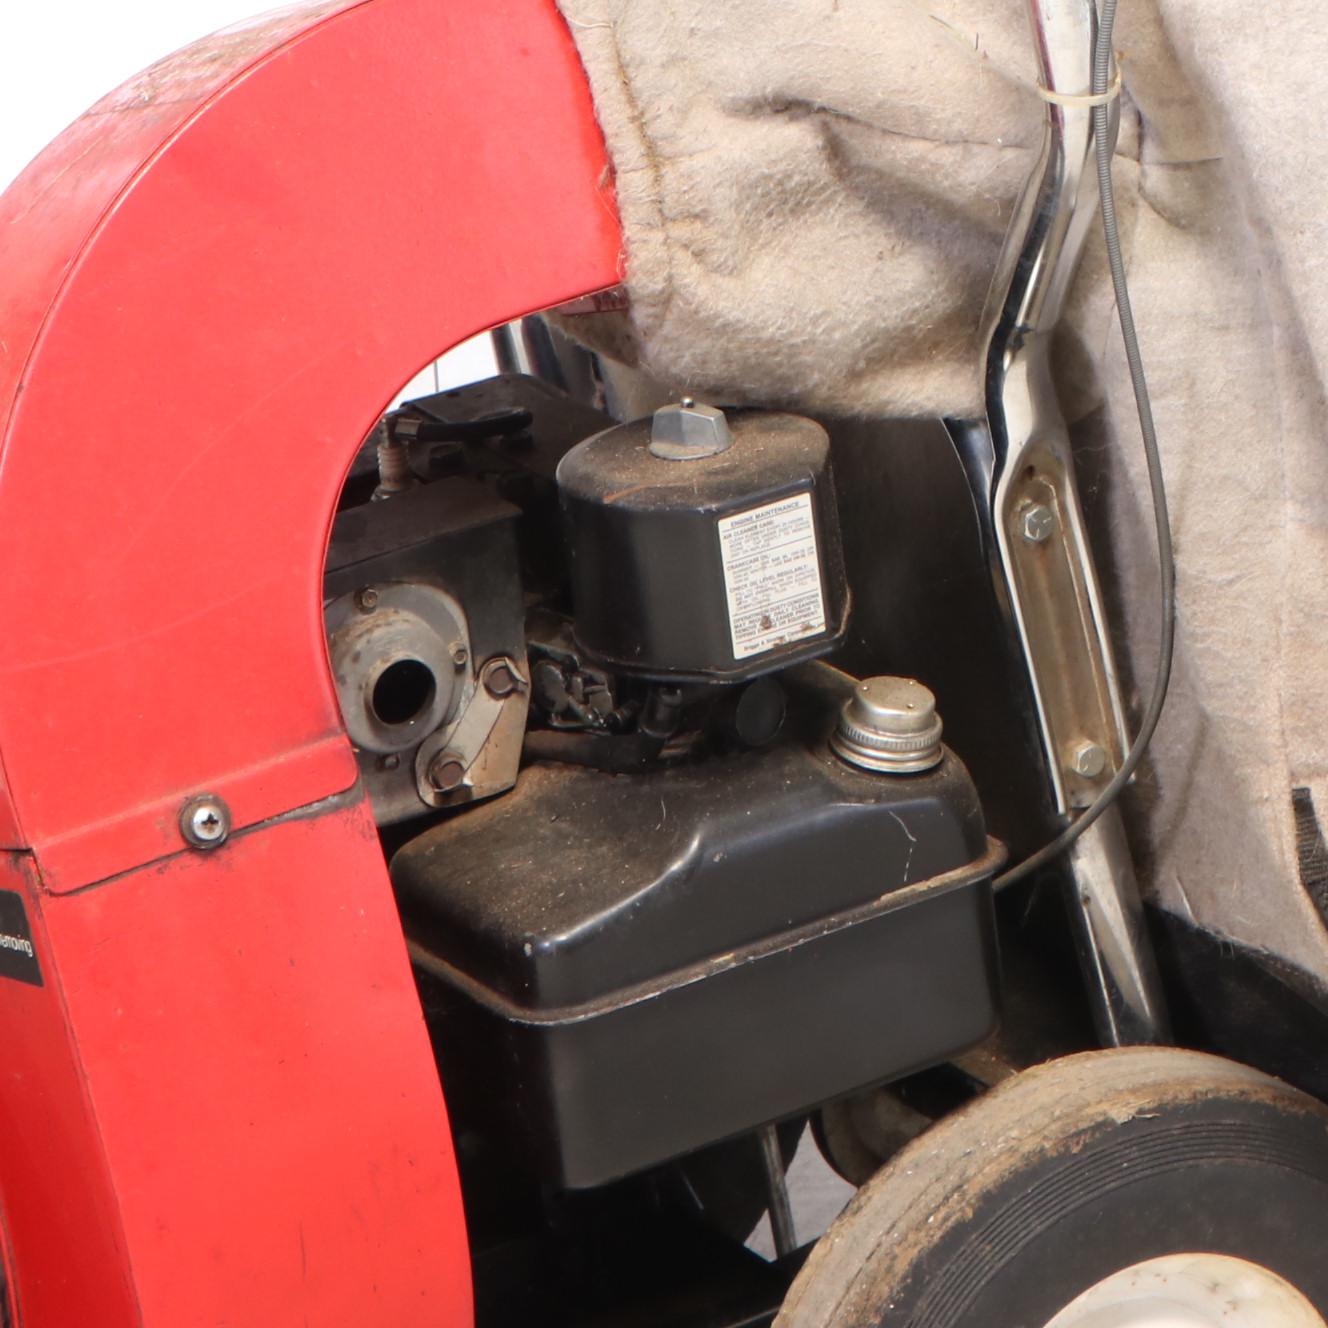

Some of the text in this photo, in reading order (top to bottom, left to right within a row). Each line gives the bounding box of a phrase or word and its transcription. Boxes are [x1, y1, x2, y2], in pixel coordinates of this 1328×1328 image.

[730, 501, 799, 527] ENGINE MAINTENANCE
[734, 524, 757, 535] CLEANER
[0, 933, 33, 957] emoving
